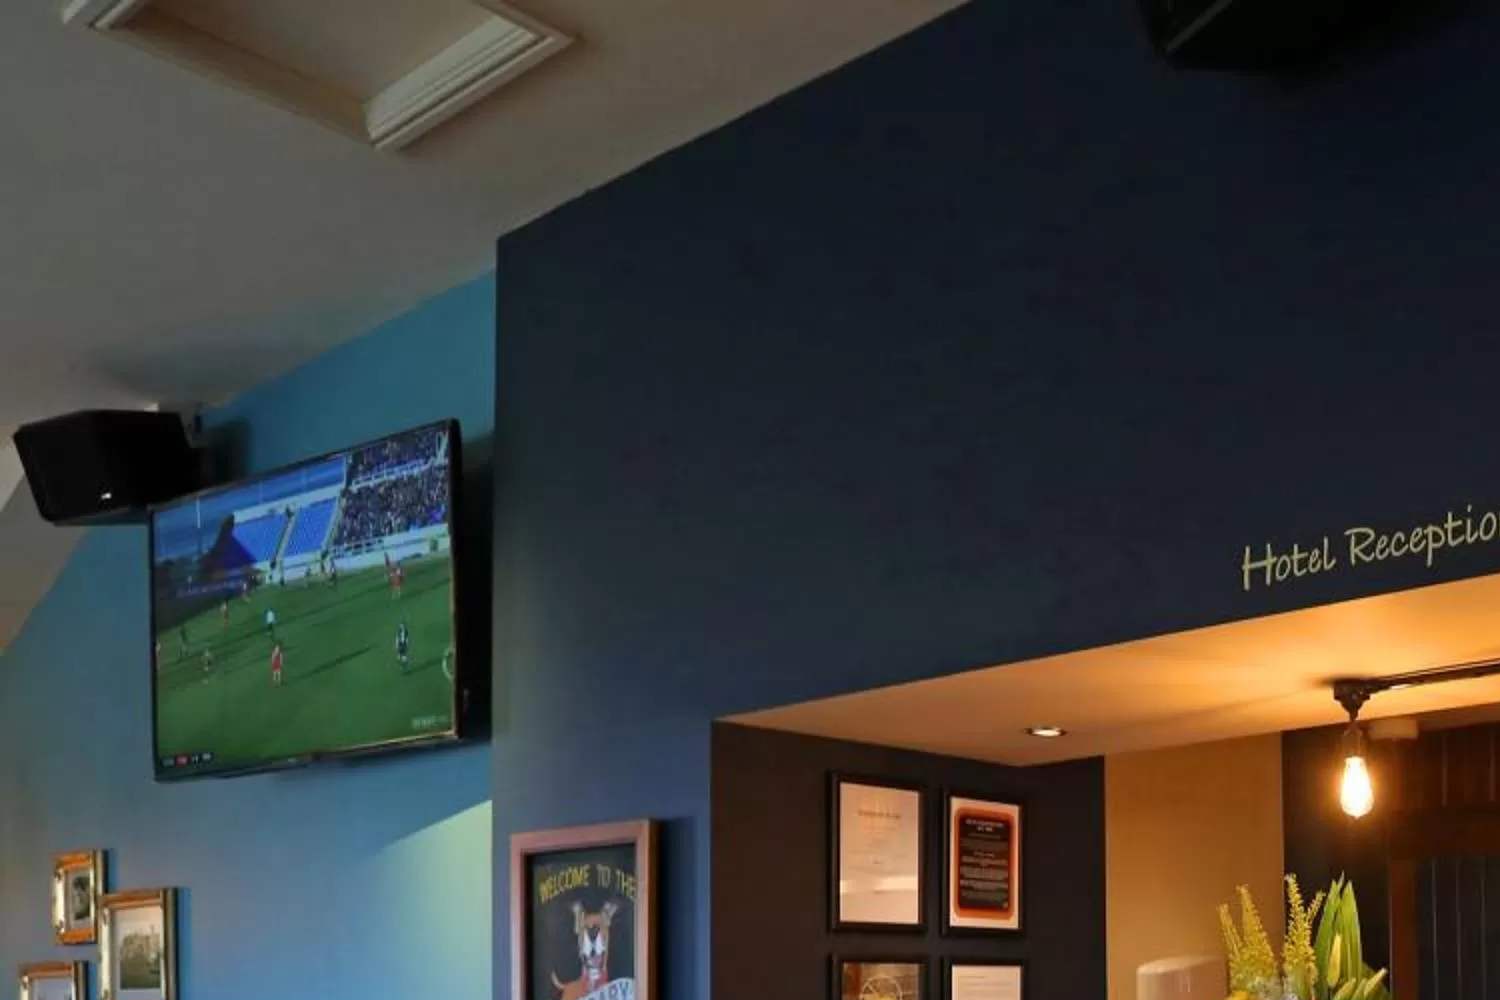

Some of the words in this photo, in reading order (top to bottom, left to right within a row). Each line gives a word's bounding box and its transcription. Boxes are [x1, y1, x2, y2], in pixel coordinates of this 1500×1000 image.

[1241, 536, 1337, 591] Hotel
[540, 863, 591, 904] WELCOME
[596, 863, 611, 889] TO
[616, 868, 637, 899] THE
